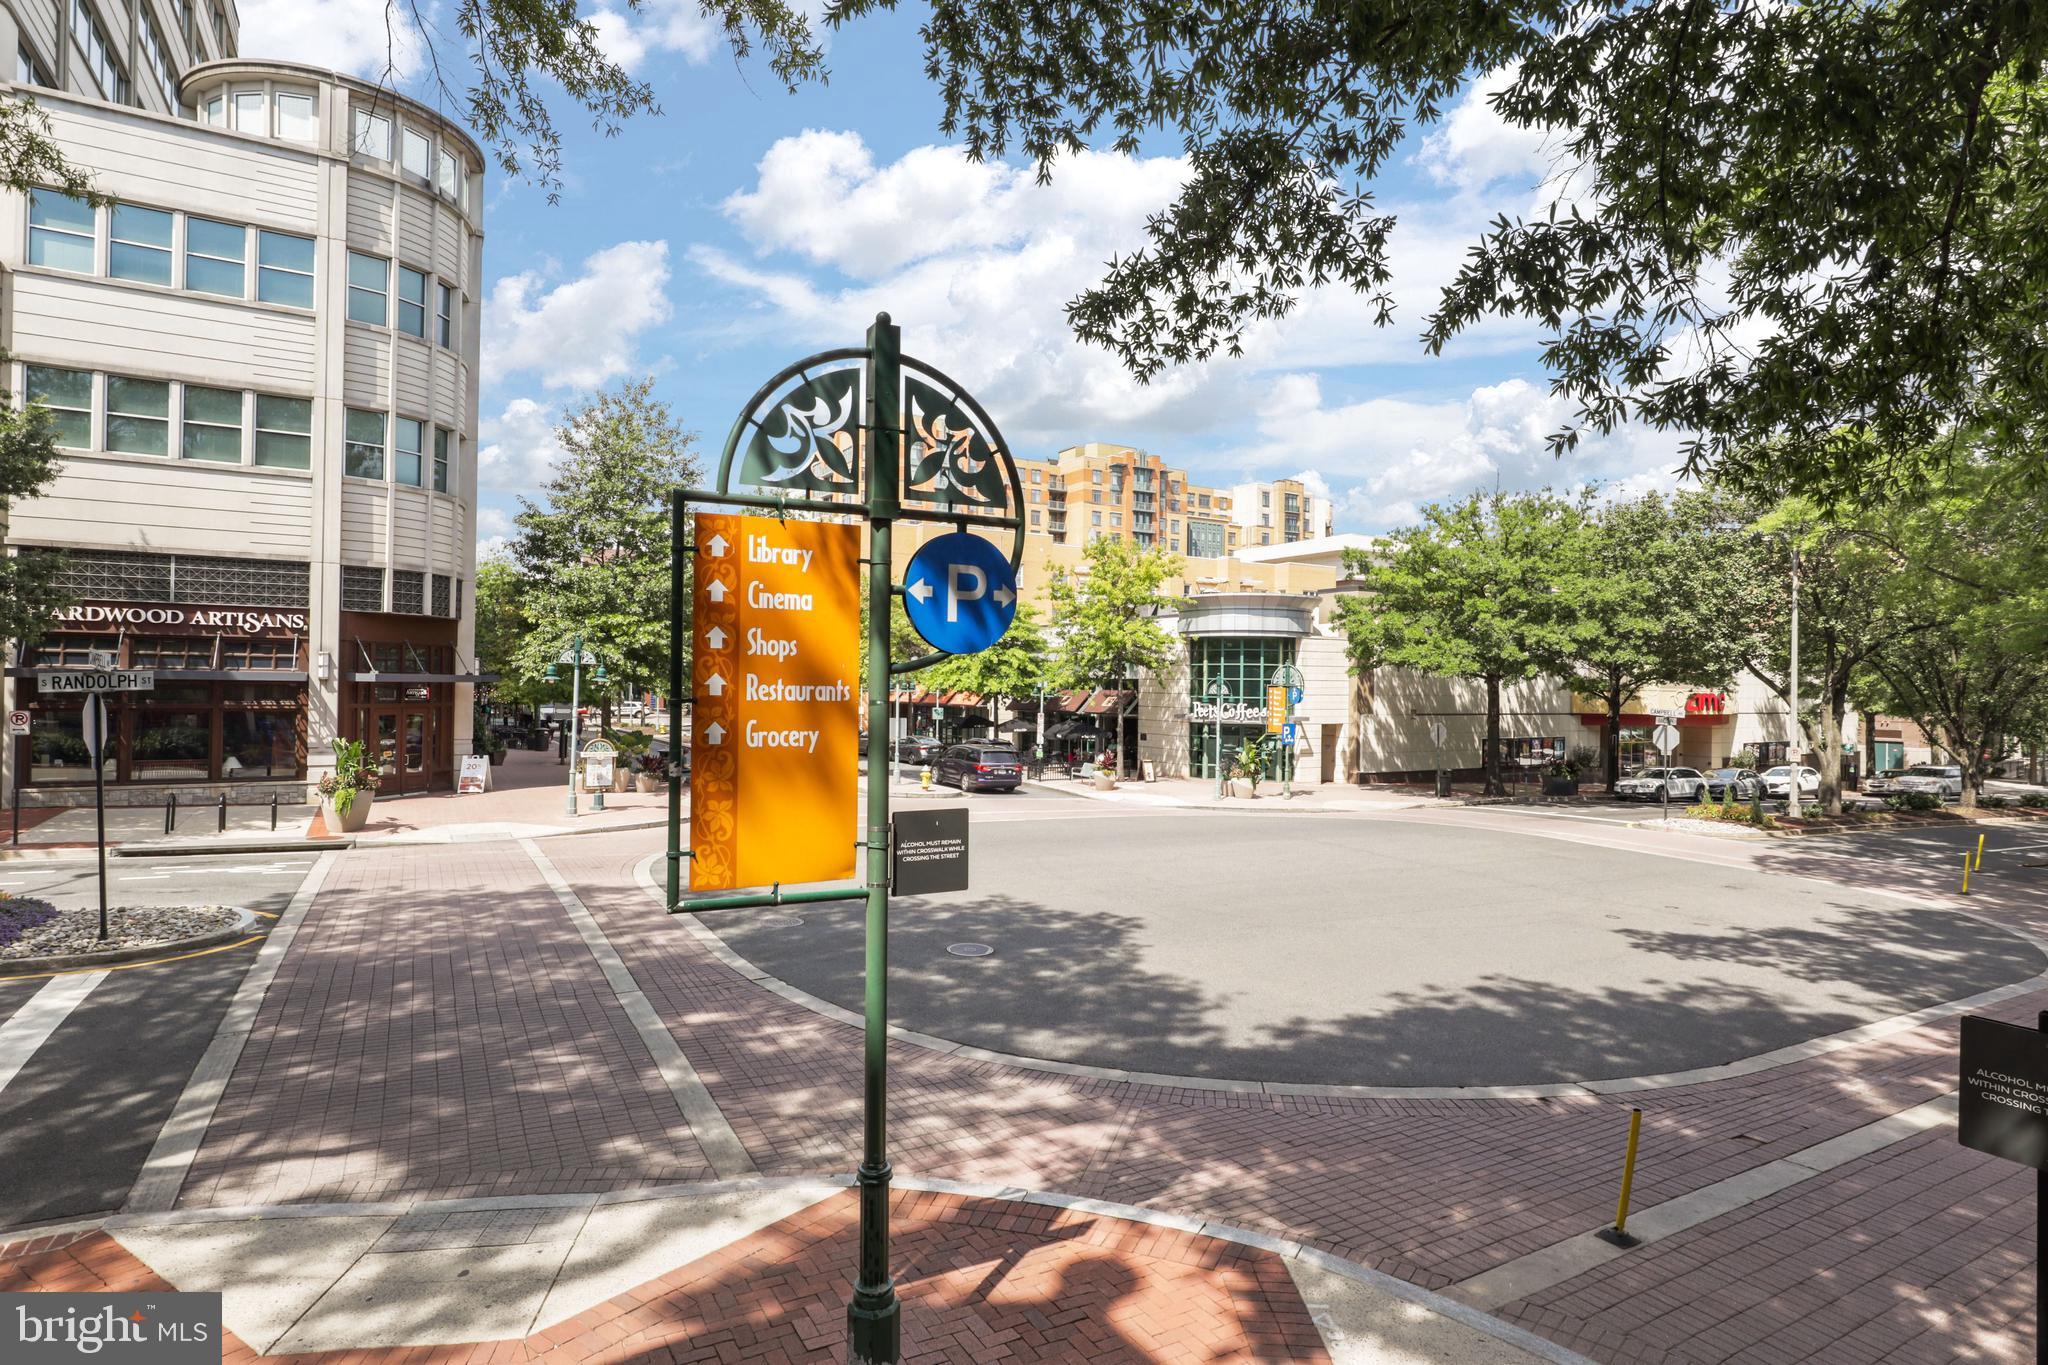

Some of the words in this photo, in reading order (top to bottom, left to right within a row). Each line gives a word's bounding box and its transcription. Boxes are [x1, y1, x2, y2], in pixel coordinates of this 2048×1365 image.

[748, 534, 813, 573] Library
[748, 580, 813, 611] Cinema
[947, 563, 987, 622] P
[28, 605, 184, 624] ARDWOOD
[189, 611, 304, 632] ARTISANS
[747, 627, 798, 662] Shops
[41, 679, 47, 687] S
[52, 674, 137, 690] RANDOLPH
[141, 676, 151, 685] ST
[746, 673, 850, 702] Restaurants
[1220, 702, 1259, 720] Coffee
[746, 719, 819, 754] Grocery
[1284, 727, 1290, 738] P
[1968, 1076, 2010, 1095] WITHIN
[1976, 1068, 2033, 1090] ALCOHOL
[1981, 1091, 2041, 1114] CROSSING
